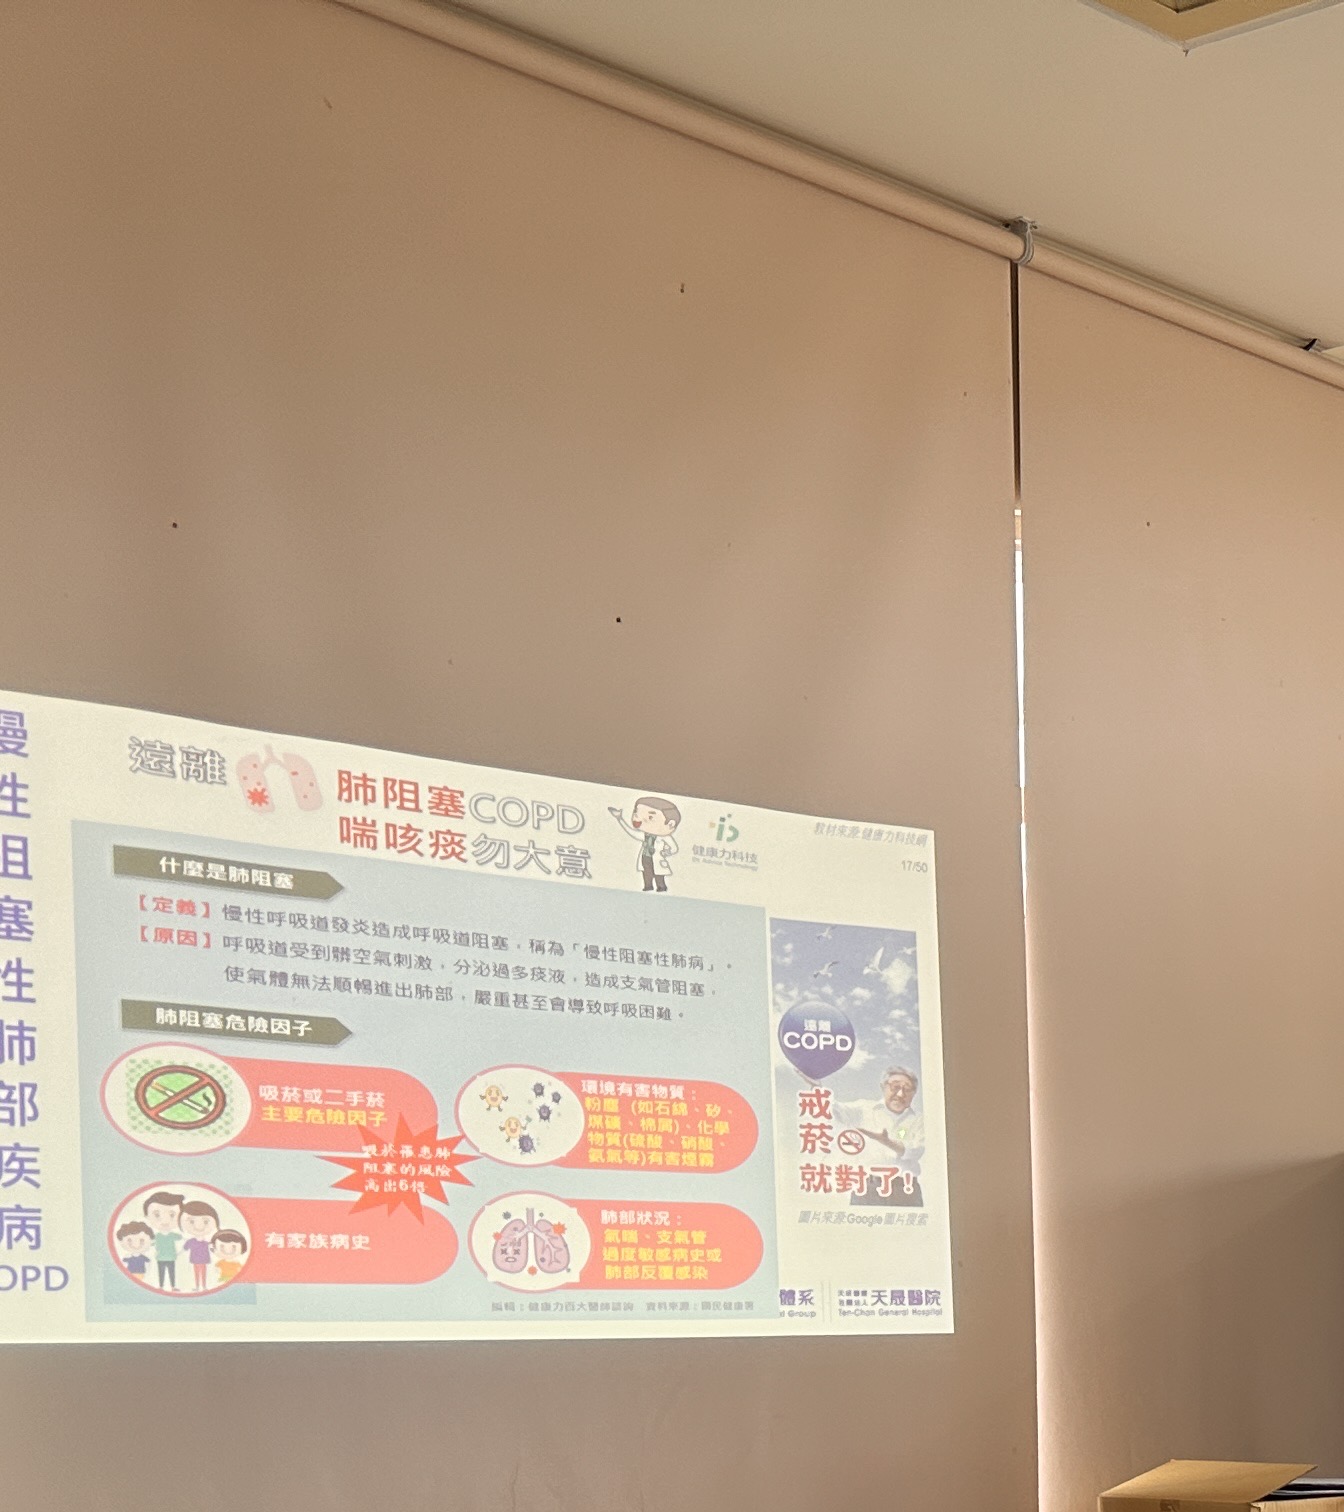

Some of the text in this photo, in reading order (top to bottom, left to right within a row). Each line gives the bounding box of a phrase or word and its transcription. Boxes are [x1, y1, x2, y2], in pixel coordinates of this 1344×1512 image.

[128, 736, 227, 787] 遠離
[338, 816, 593, 879] 喘咳痰勿大意
[159, 856, 294, 889] 什麼是肺阻塞
[901, 860, 929, 873] 17/50
[155, 1007, 313, 1037] 肺阻塞危險因子
[783, 1031, 852, 1052] COPD
[258, 1084, 386, 1108] 吸菸或二手菸
[261, 1105, 388, 1127] 主要危險因子
[264, 1231, 371, 1251] 有家族病史
[604, 1264, 709, 1281] 肺部反覆感染
